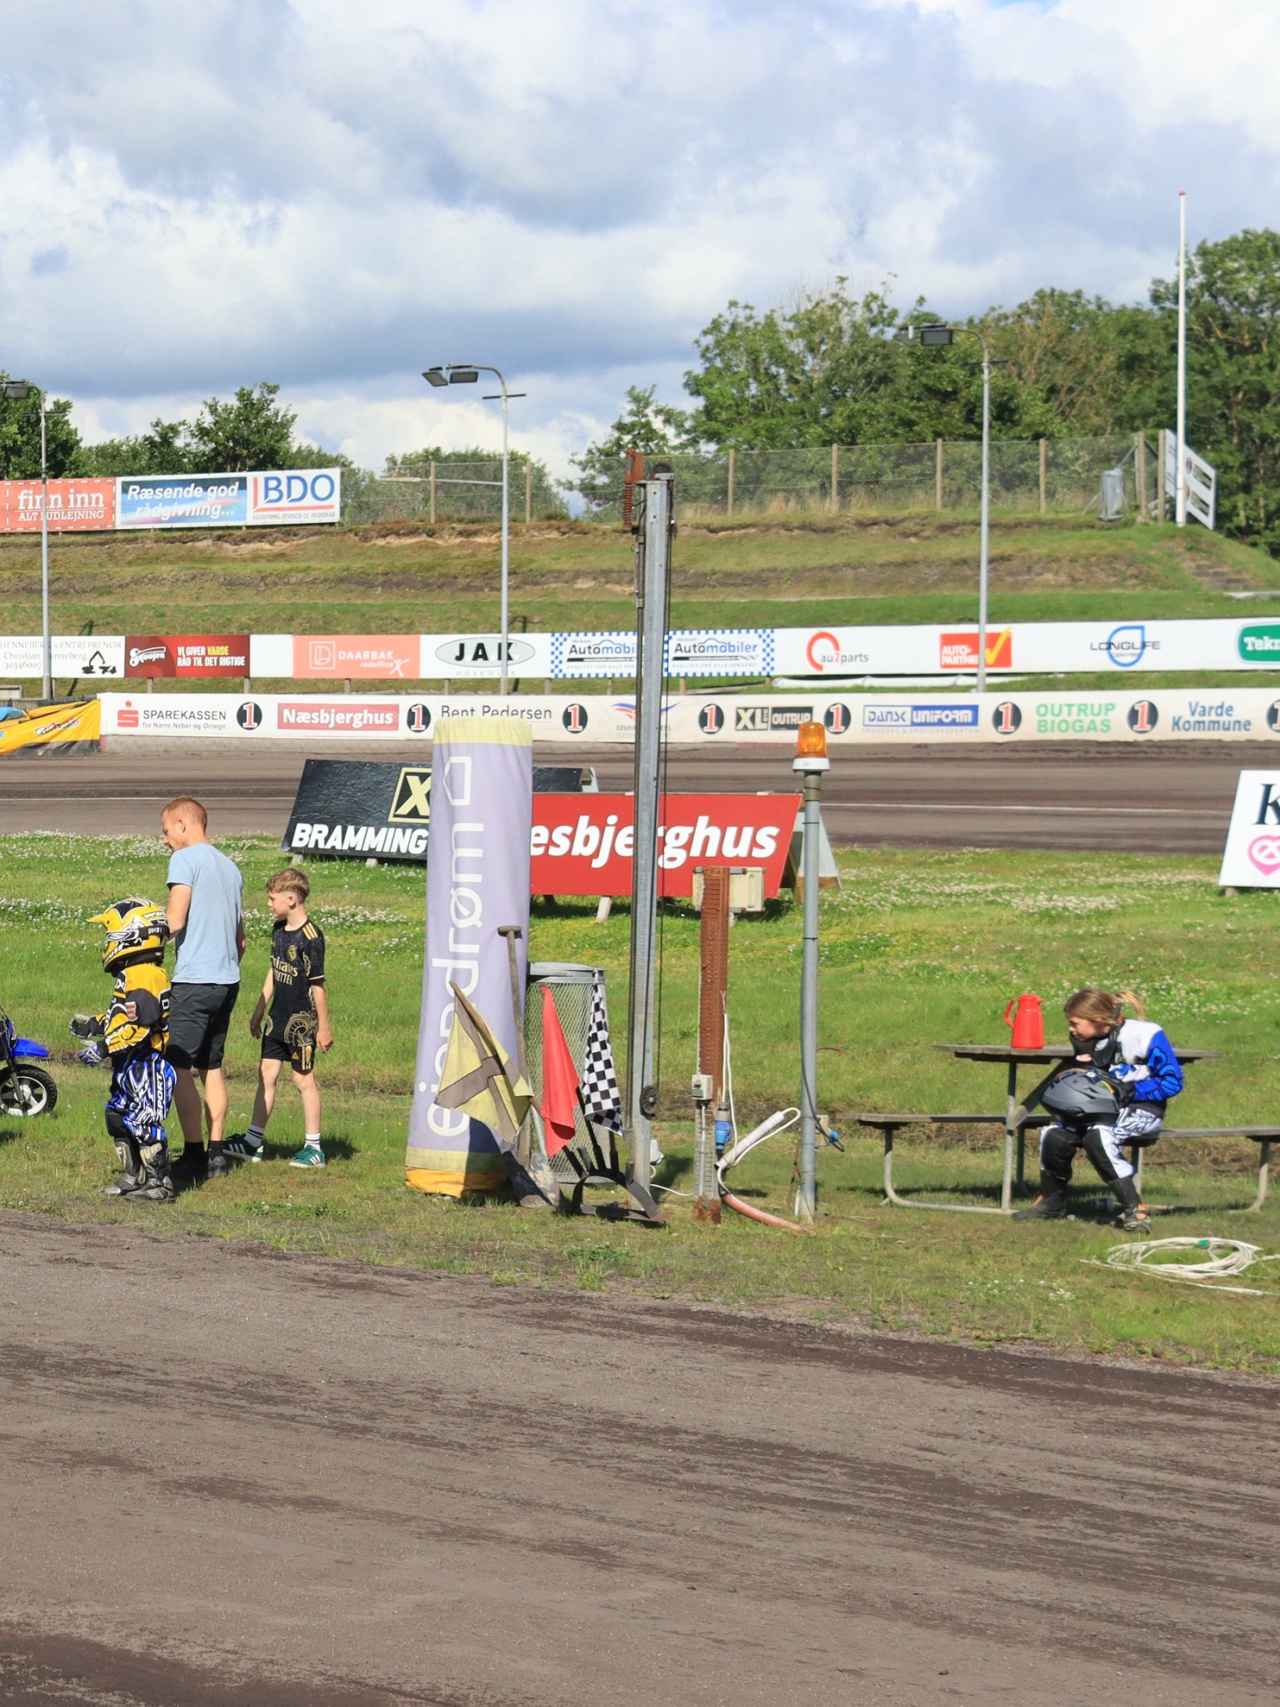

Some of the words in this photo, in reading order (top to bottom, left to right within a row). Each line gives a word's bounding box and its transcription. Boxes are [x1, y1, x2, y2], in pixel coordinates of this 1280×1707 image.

[208, 482, 240, 499] god
[264, 474, 335, 503] BDO
[69, 489, 104, 508] inn
[674, 643, 757, 653] Automobiler
[143, 709, 227, 721] SPAREKASSEN
[1035, 703, 1116, 717] OUTRUP
[1188, 701, 1233, 717] Varde
[283, 708, 393, 728] Næsbjerghus
[1036, 719, 1111, 733] BIOGAS
[1172, 716, 1252, 732] Kommune
[291, 823, 429, 855] BRAMMING
